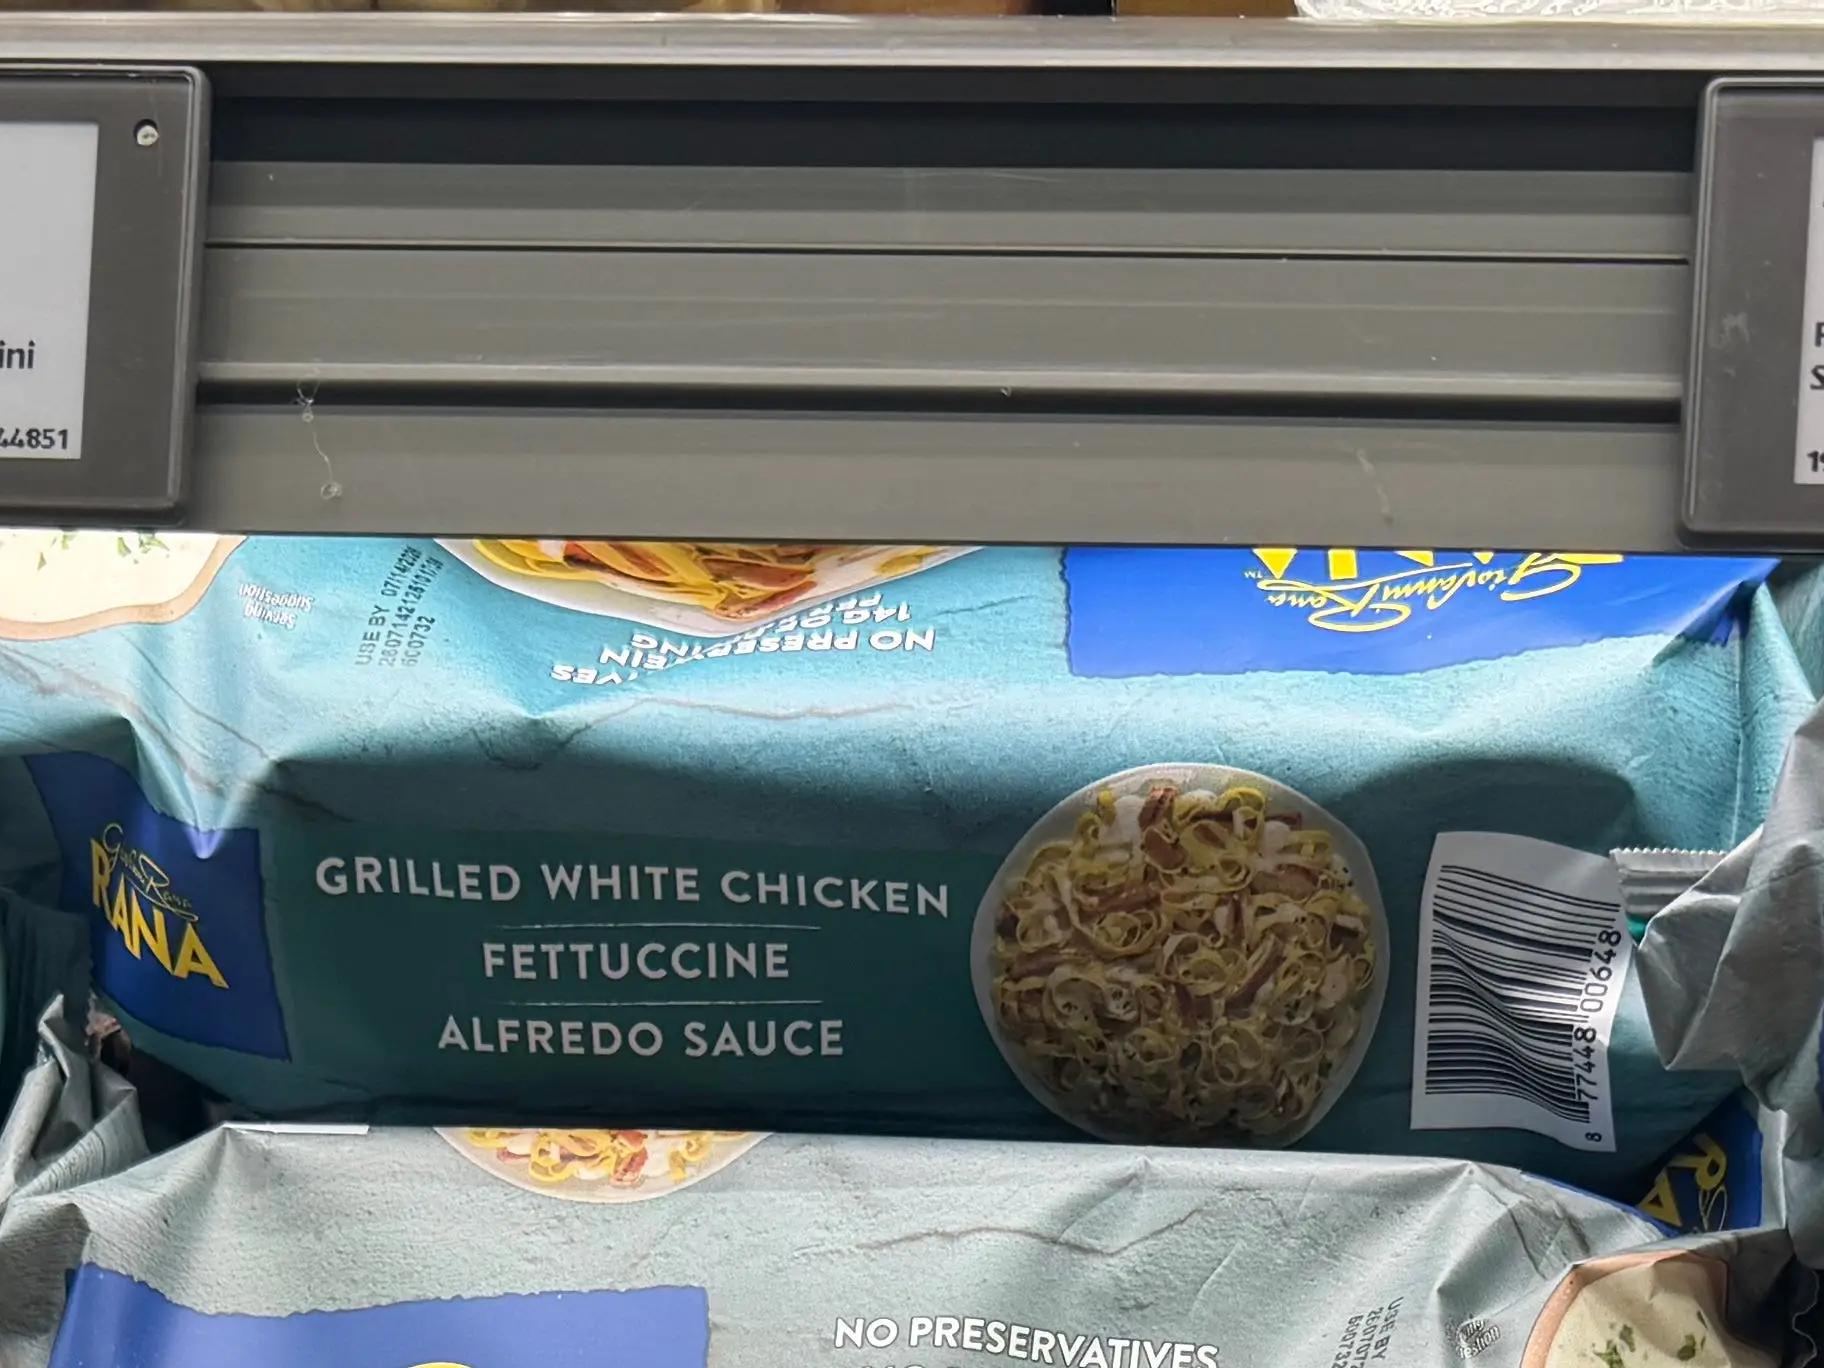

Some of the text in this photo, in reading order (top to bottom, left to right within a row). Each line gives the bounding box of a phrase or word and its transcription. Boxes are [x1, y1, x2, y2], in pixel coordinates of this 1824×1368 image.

[314, 857, 950, 917] GRILLED WHITE CHICKEN
[89, 838, 229, 990] RANA
[482, 942, 790, 979] FETTUCCINE
[1579, 930, 1622, 1012] 00648
[438, 1016, 845, 1058] ALFREDO SAUCE
[1574, 1026, 1599, 1102] 77448
[834, 1316, 901, 1351] NO
[1372, 1336, 1391, 1361] BY
